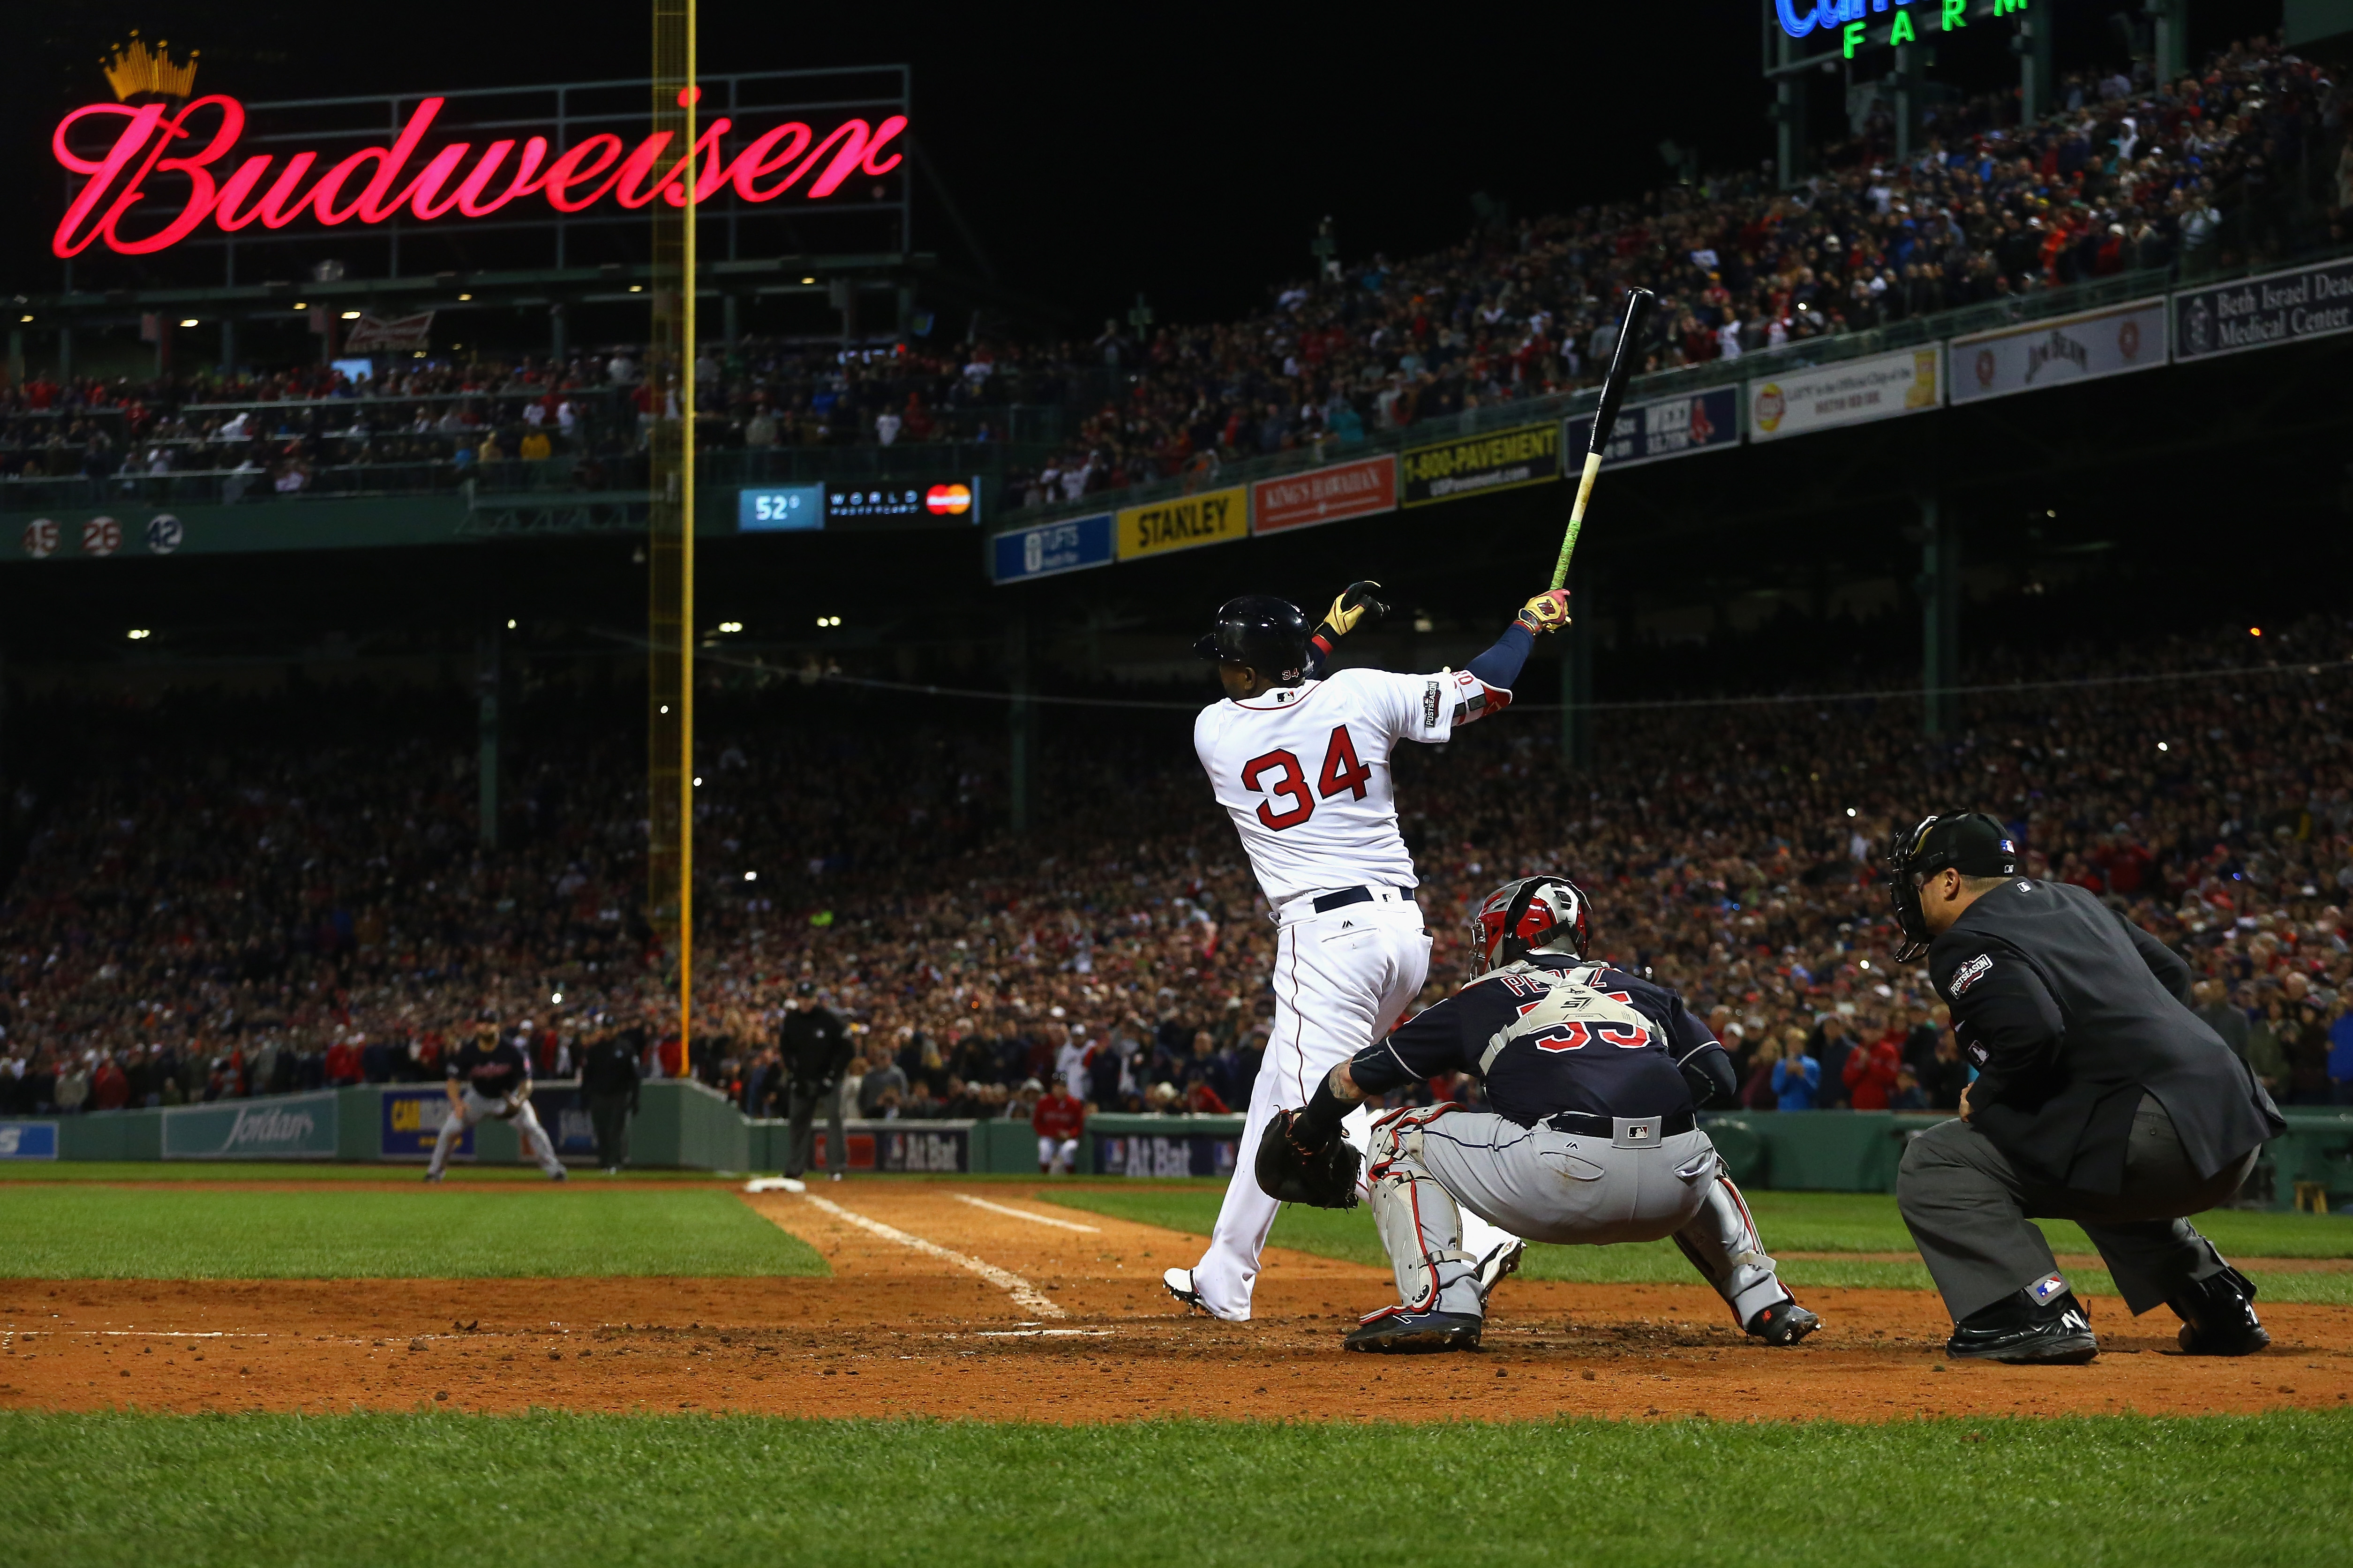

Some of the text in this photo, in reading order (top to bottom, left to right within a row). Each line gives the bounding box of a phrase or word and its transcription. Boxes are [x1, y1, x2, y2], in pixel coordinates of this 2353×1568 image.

[53, 85, 908, 258] Budweiser
[2217, 286, 2257, 319] Beth
[2262, 274, 2310, 309] Israel
[2218, 307, 2350, 347] Medical Center
[830, 490, 918, 505] WORLD
[22, 521, 180, 553] 45 26 42
[1138, 497, 1229, 548] STANLEY
[1282, 668, 1299, 680] 34
[1426, 682, 1438, 726] POSTSEASON
[1240, 724, 1372, 833] 34
[1500, 968, 1607, 997] PEZ
[1950, 957, 1989, 996] POSTSEASON
[1152, 1136, 1192, 1177] Bat
